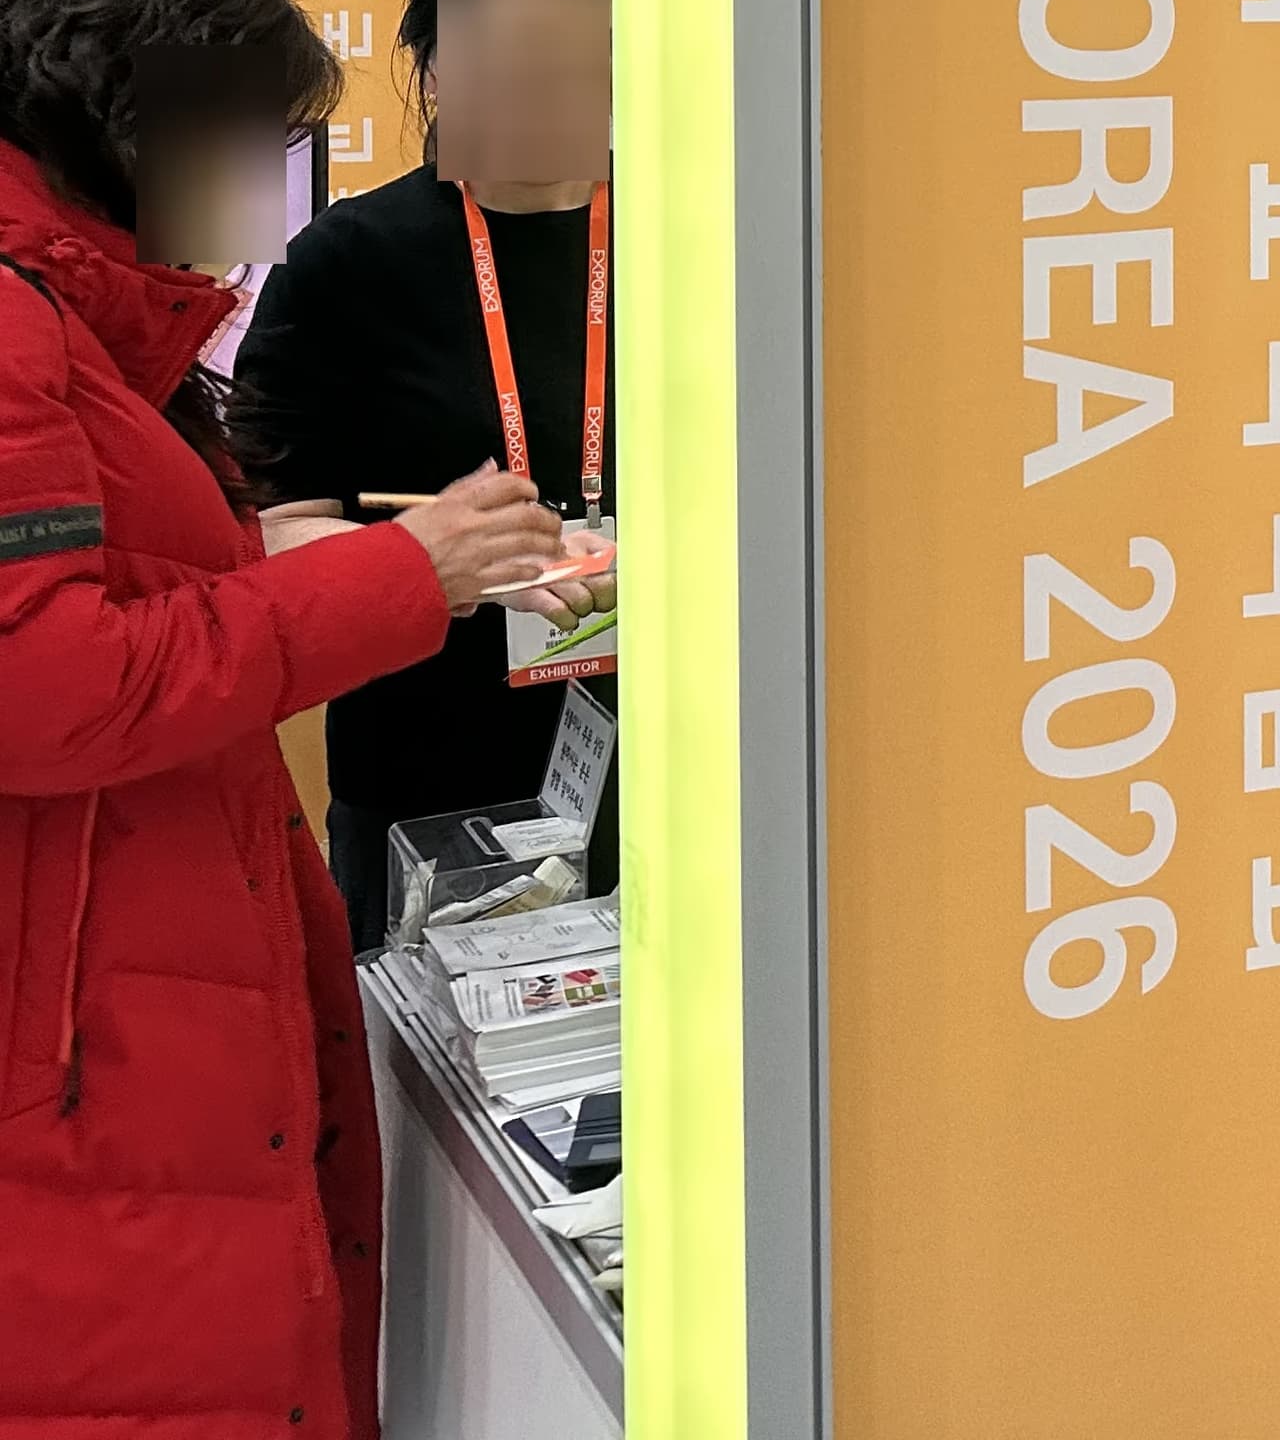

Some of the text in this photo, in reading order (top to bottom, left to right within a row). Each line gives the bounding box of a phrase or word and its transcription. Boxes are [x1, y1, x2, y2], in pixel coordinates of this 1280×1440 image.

[474, 237, 499, 313] EXPORUM
[590, 249, 605, 325] EXPORUM
[503, 392, 526, 473] EXPORUM
[530, 661, 599, 680] EXHIBITOR
[1022, 536, 1178, 1019] 2026
